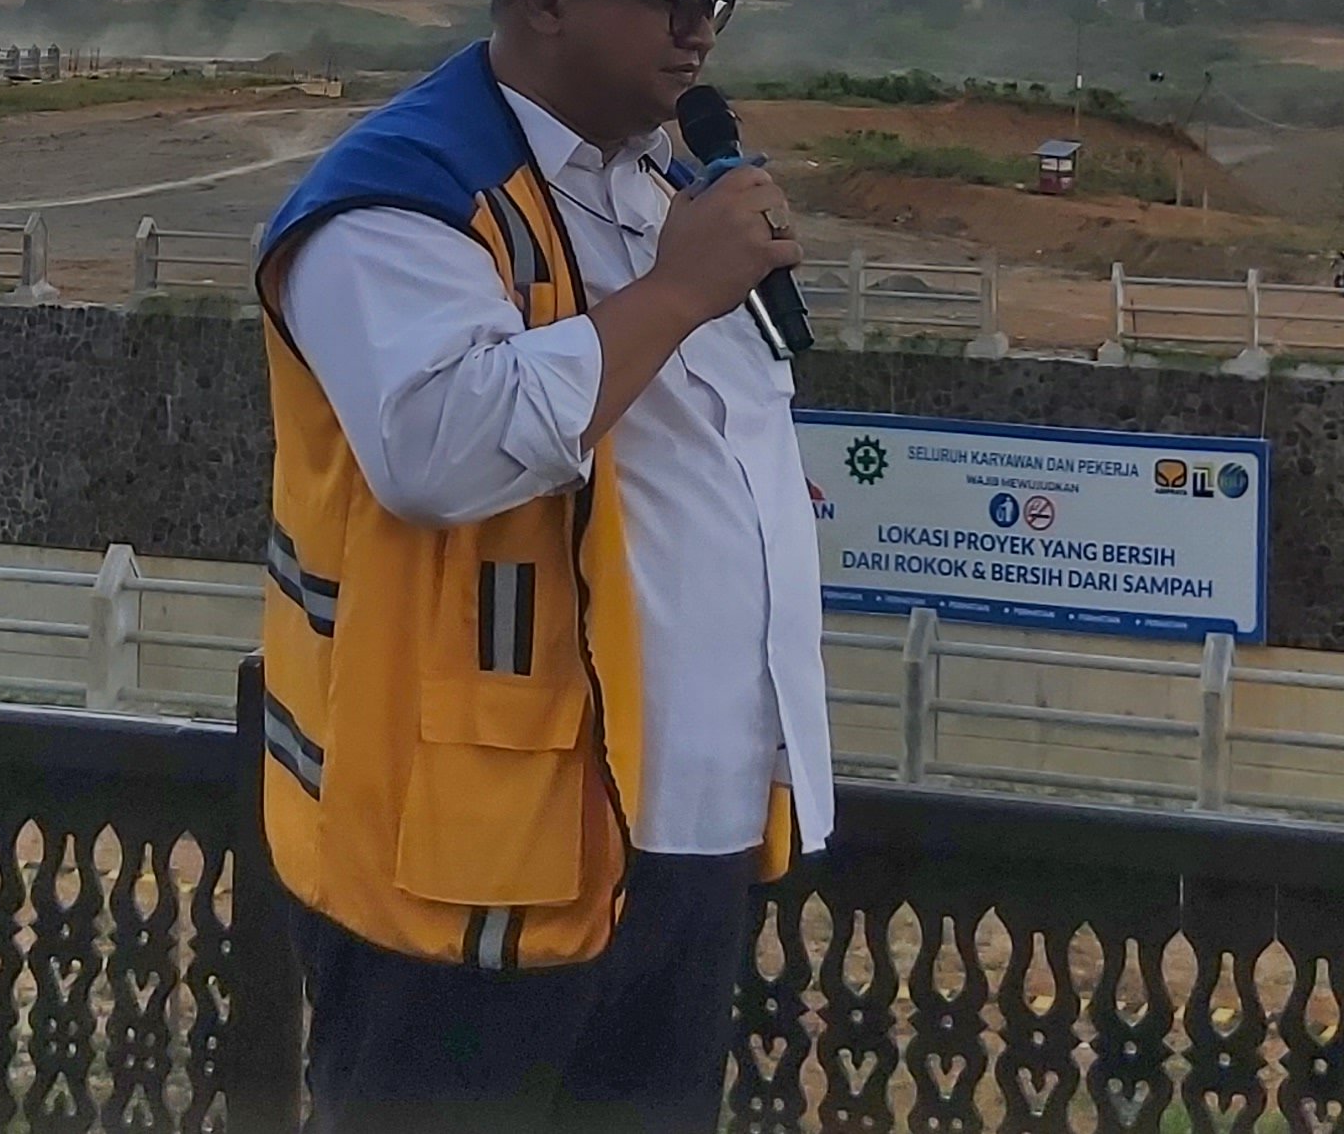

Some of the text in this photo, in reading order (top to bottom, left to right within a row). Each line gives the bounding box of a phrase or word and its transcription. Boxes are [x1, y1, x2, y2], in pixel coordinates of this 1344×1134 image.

[908, 446, 1139, 477] SELURUH KARYAWAN DAN PEKERJA
[877, 525, 1176, 567] LOKASI PROYEK YANG BERSIH
[842, 550, 1213, 598] DARI ROKOK & BERSIH DARI SAMPAH
